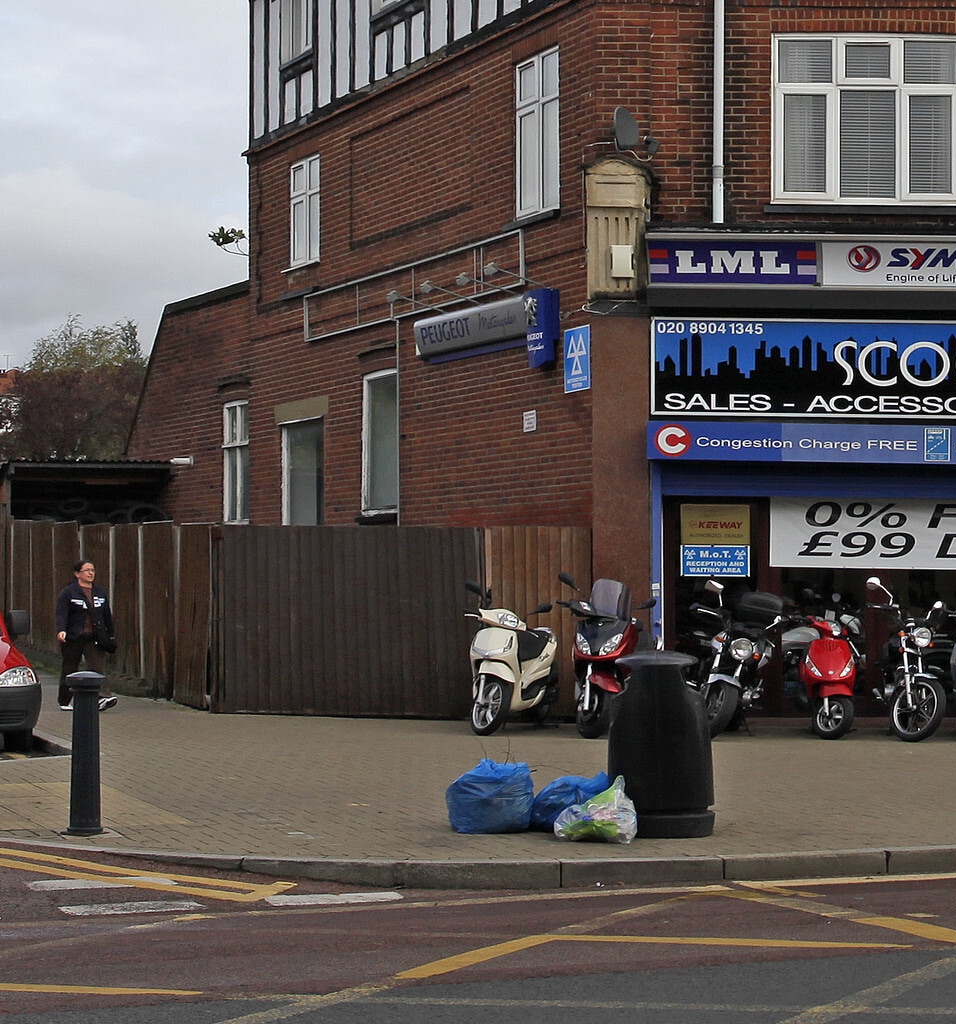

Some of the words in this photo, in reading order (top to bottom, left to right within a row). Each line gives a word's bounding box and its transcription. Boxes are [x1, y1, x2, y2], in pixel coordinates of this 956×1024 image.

[675, 250, 790, 274] LML
[886, 273, 925, 284] Engine
[928, 273, 940, 283] of
[420, 317, 471, 346] PEUGEOT
[657, 322, 685, 334] 020
[689, 323, 726, 334] 8904
[729, 323, 764, 335] 1345
[664, 393, 772, 411] SALES
[696, 437, 793, 450] Congestion
[799, 438, 861, 451] Charge
[867, 440, 918, 451] FREE
[804, 501, 907, 528] 0%
[698, 521, 743, 529] KEEWAY
[798, 531, 916, 558] £99
[699, 550, 732, 558] M.o.T.
